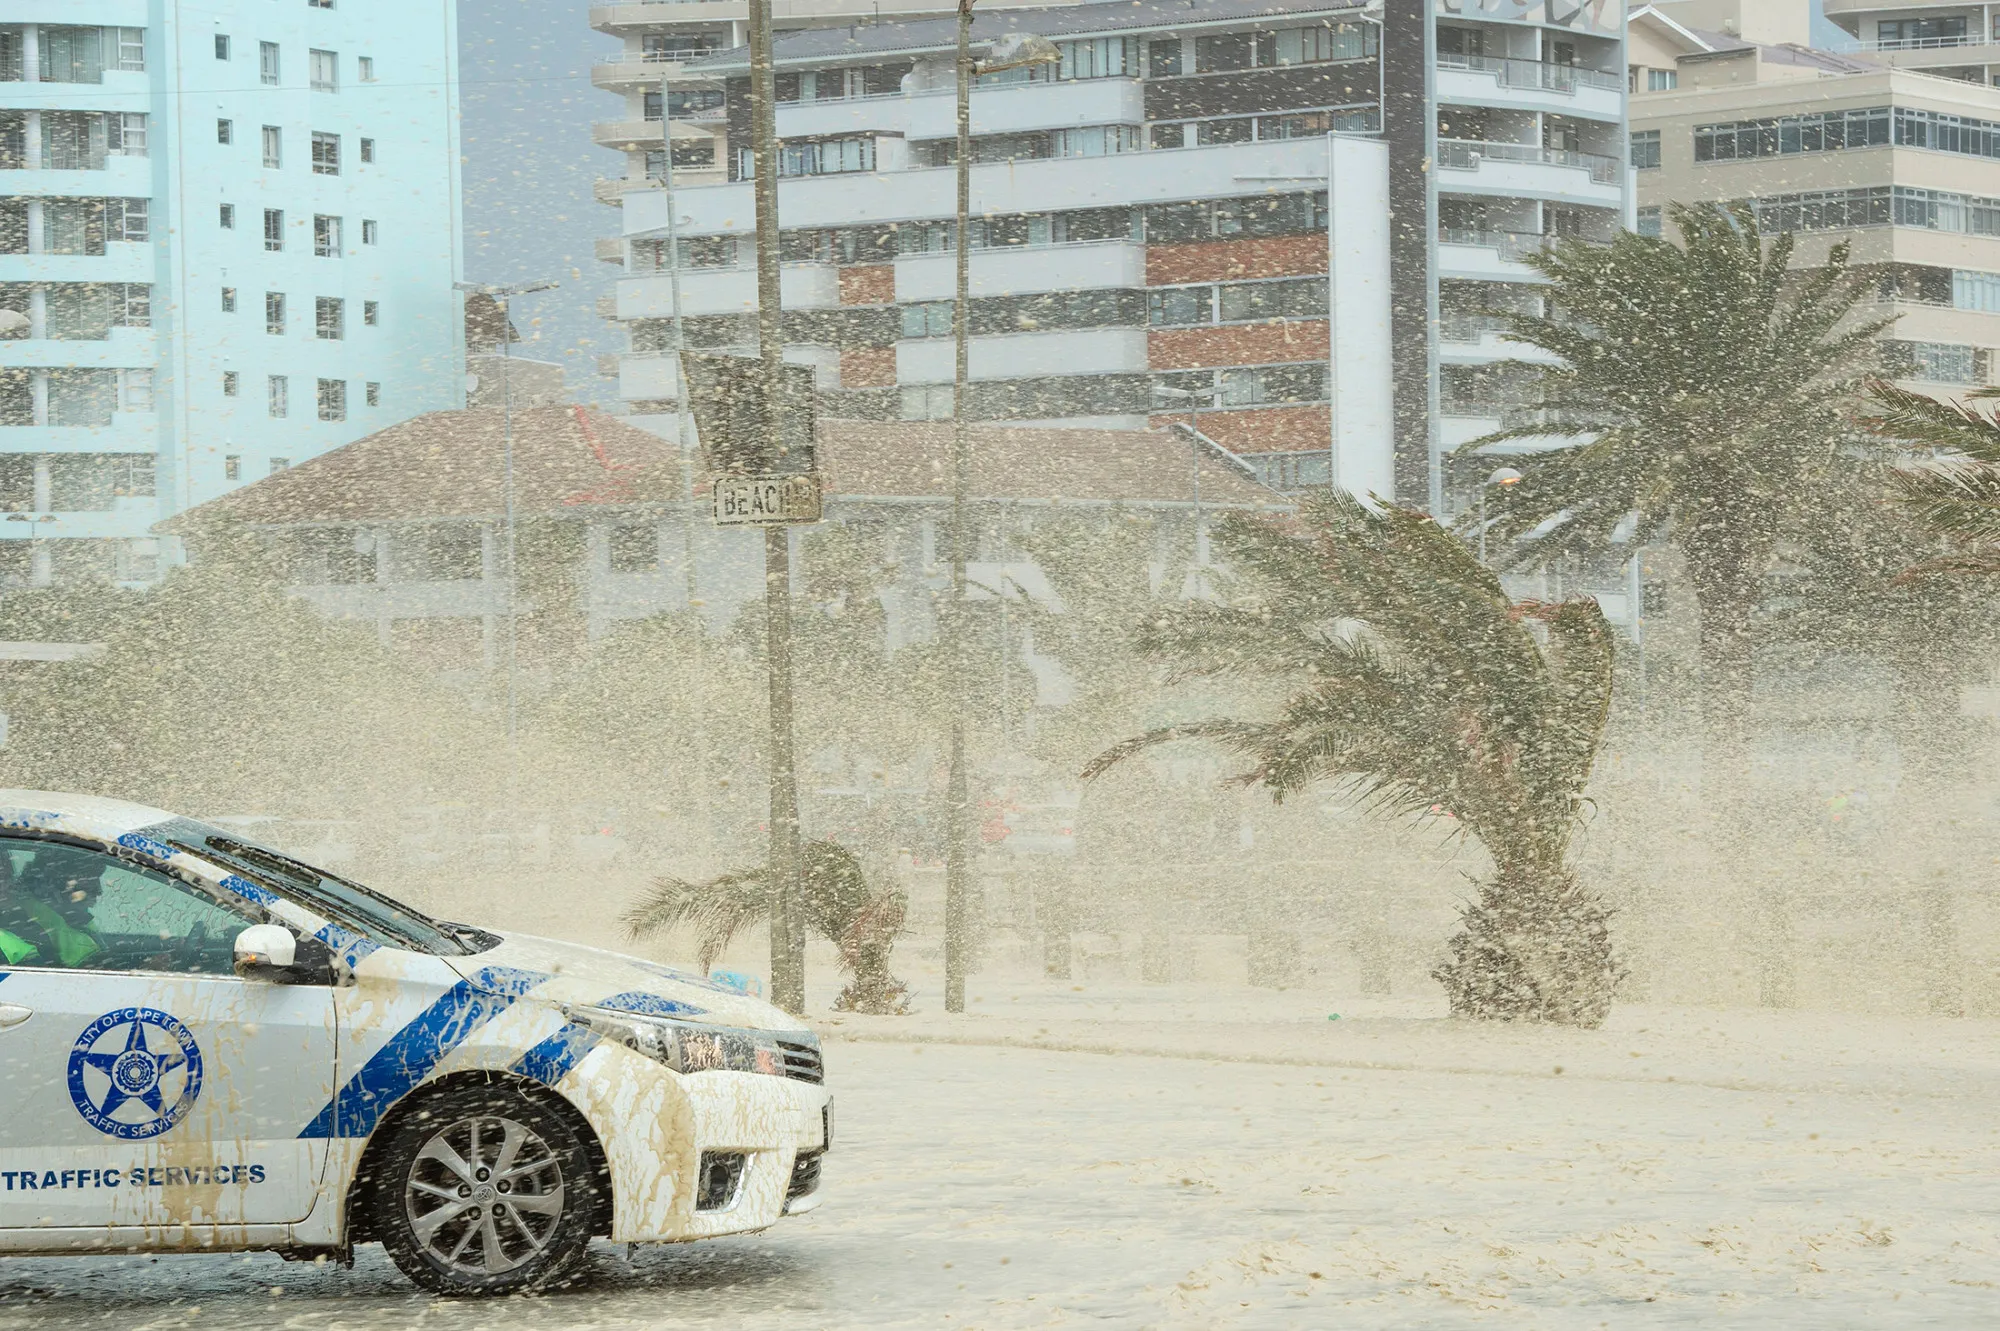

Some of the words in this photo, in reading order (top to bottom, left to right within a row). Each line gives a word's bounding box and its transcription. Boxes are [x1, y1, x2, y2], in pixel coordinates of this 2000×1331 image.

[78, 1022, 101, 1050] CITY
[102, 1011, 120, 1027] OF
[124, 1009, 160, 1023] CAPE
[163, 1014, 195, 1052] TOWN
[79, 1098, 127, 1137] TRAFFIC
[131, 1100, 189, 1137] SERVICES
[2, 1168, 121, 1191] TRAFFIC
[129, 1164, 266, 1188] SERVICES
